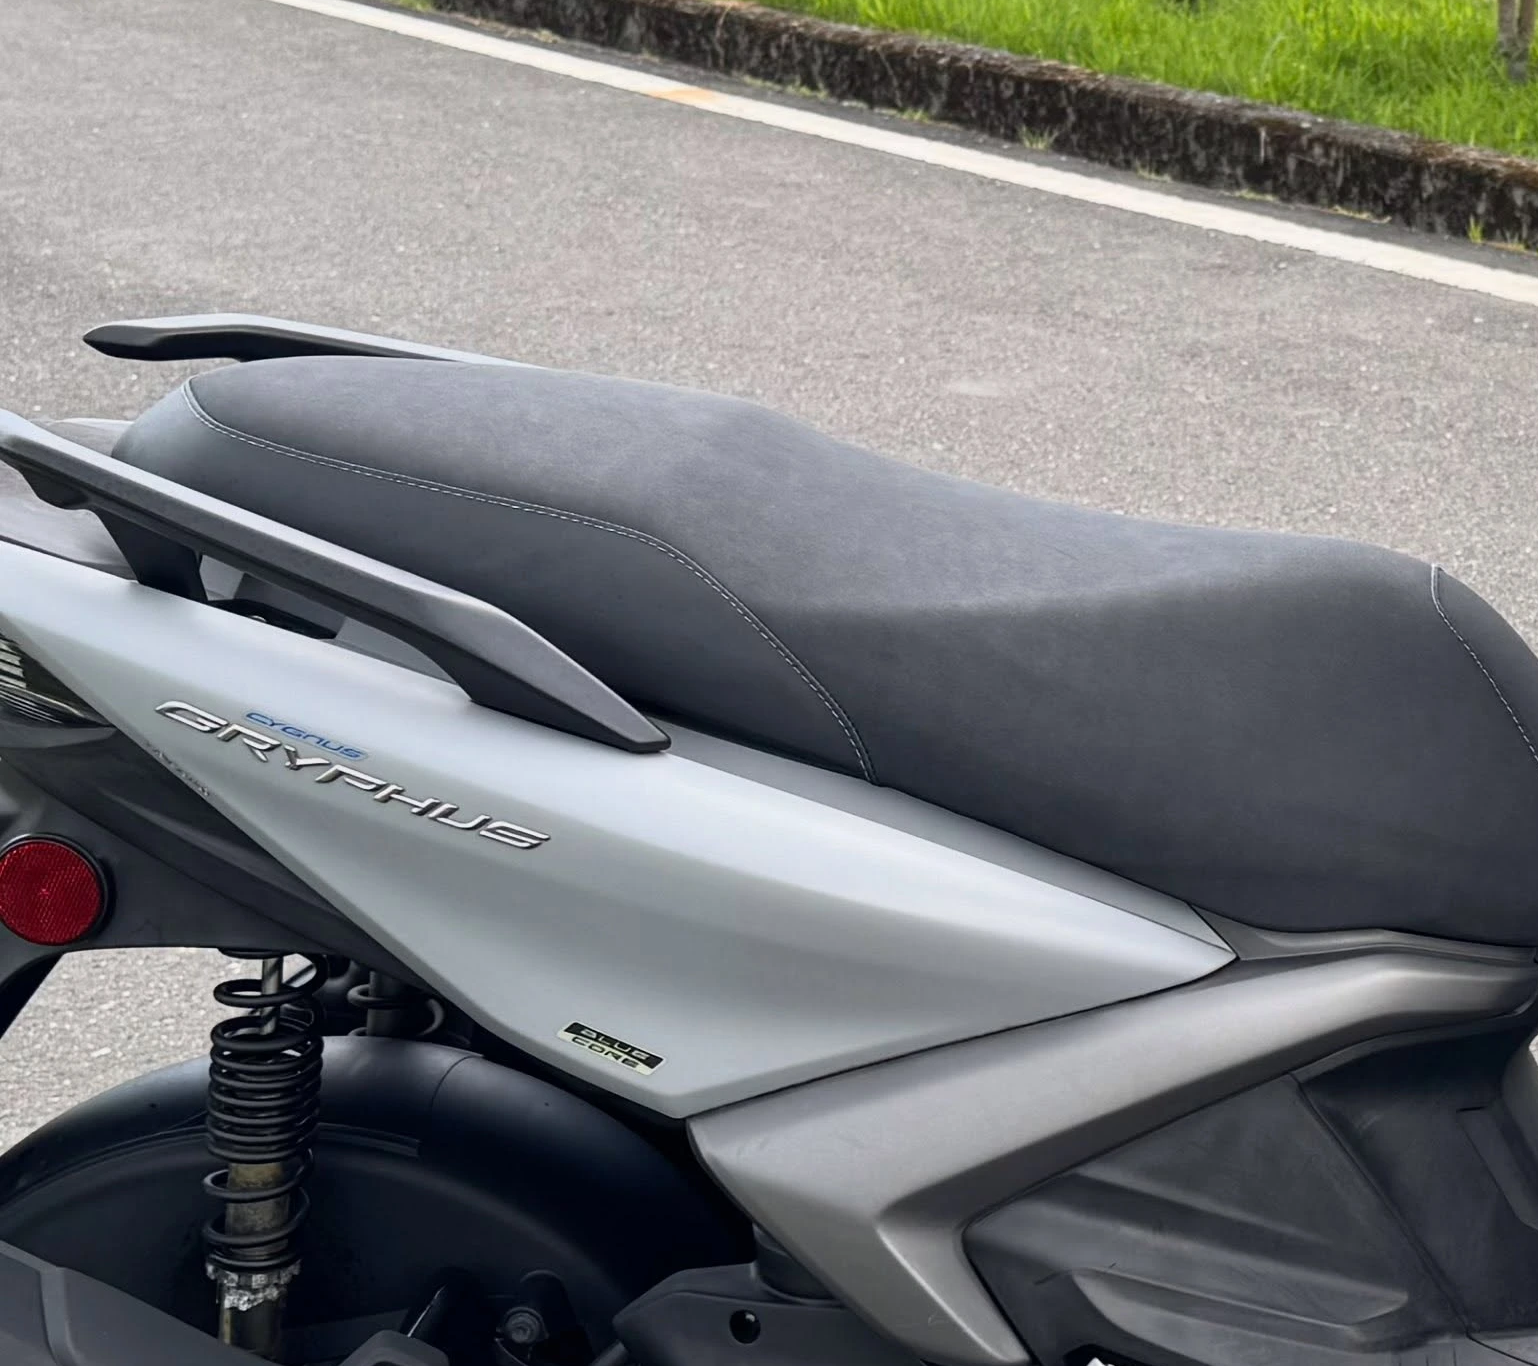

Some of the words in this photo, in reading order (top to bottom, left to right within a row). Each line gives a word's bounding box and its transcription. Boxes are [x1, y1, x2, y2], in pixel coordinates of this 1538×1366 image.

[246, 712, 363, 759] CYGNUS
[155, 700, 551, 849] GRYPHUS
[571, 1036, 640, 1068] CORE
